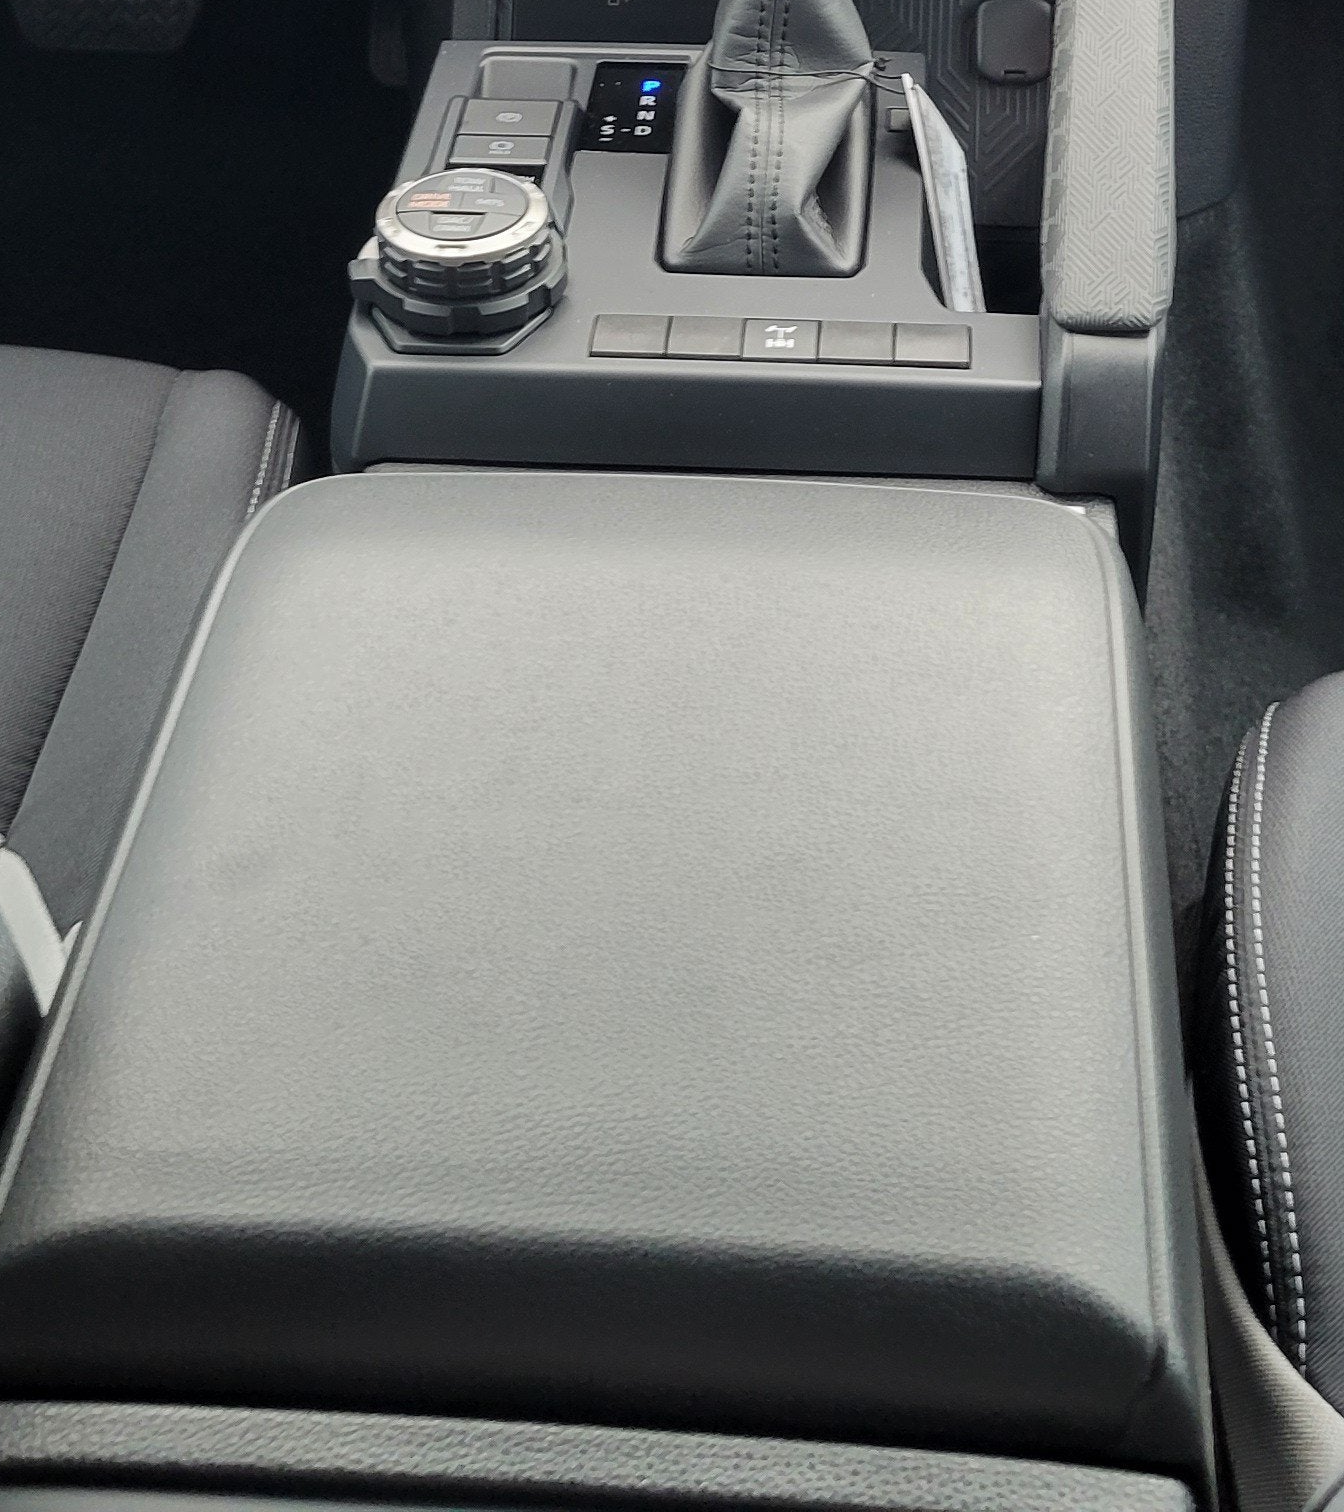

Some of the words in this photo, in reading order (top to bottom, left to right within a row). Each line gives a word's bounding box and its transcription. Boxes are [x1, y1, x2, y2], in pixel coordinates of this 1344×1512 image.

[641, 79, 662, 93] P
[638, 94, 657, 106] R
[636, 110, 656, 121] N
[600, 124, 616, 136] S
[633, 125, 653, 136] D
